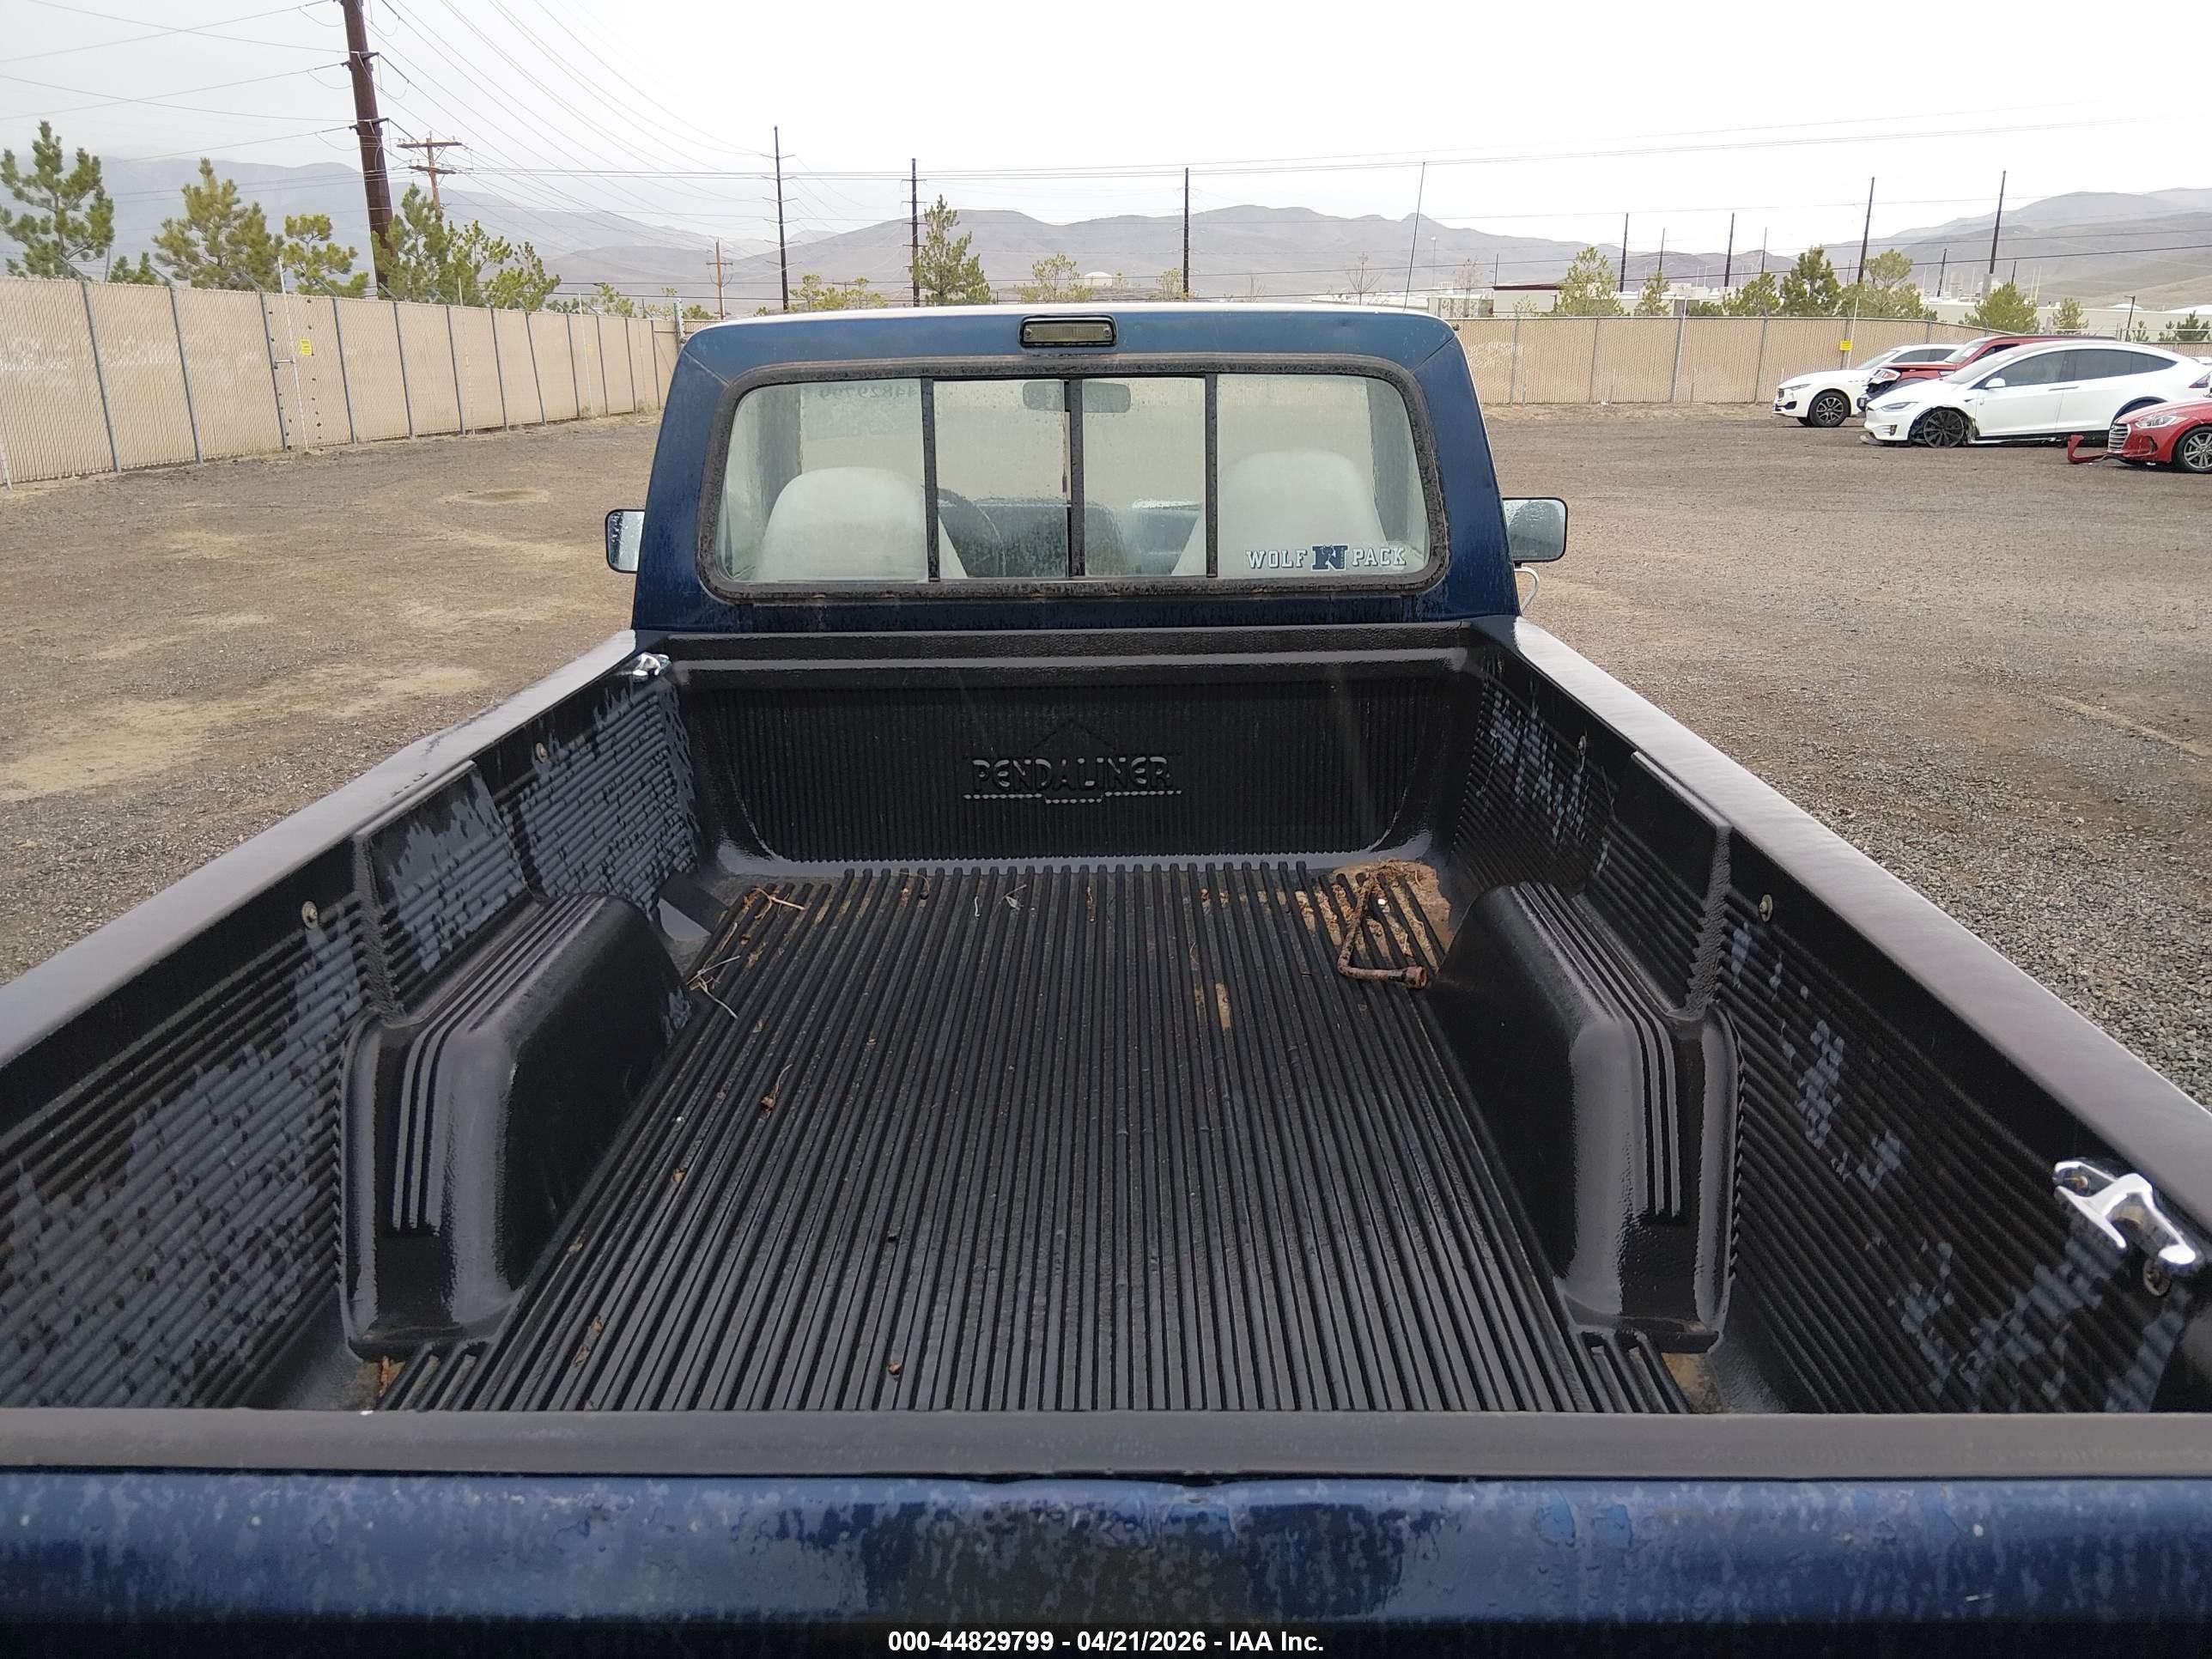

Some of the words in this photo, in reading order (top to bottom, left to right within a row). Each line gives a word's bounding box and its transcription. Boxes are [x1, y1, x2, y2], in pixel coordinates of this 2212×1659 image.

[1246, 550, 1307, 568] WOLF
[1352, 548, 1407, 567] PACK
[971, 757, 1172, 791] PENDALINER
